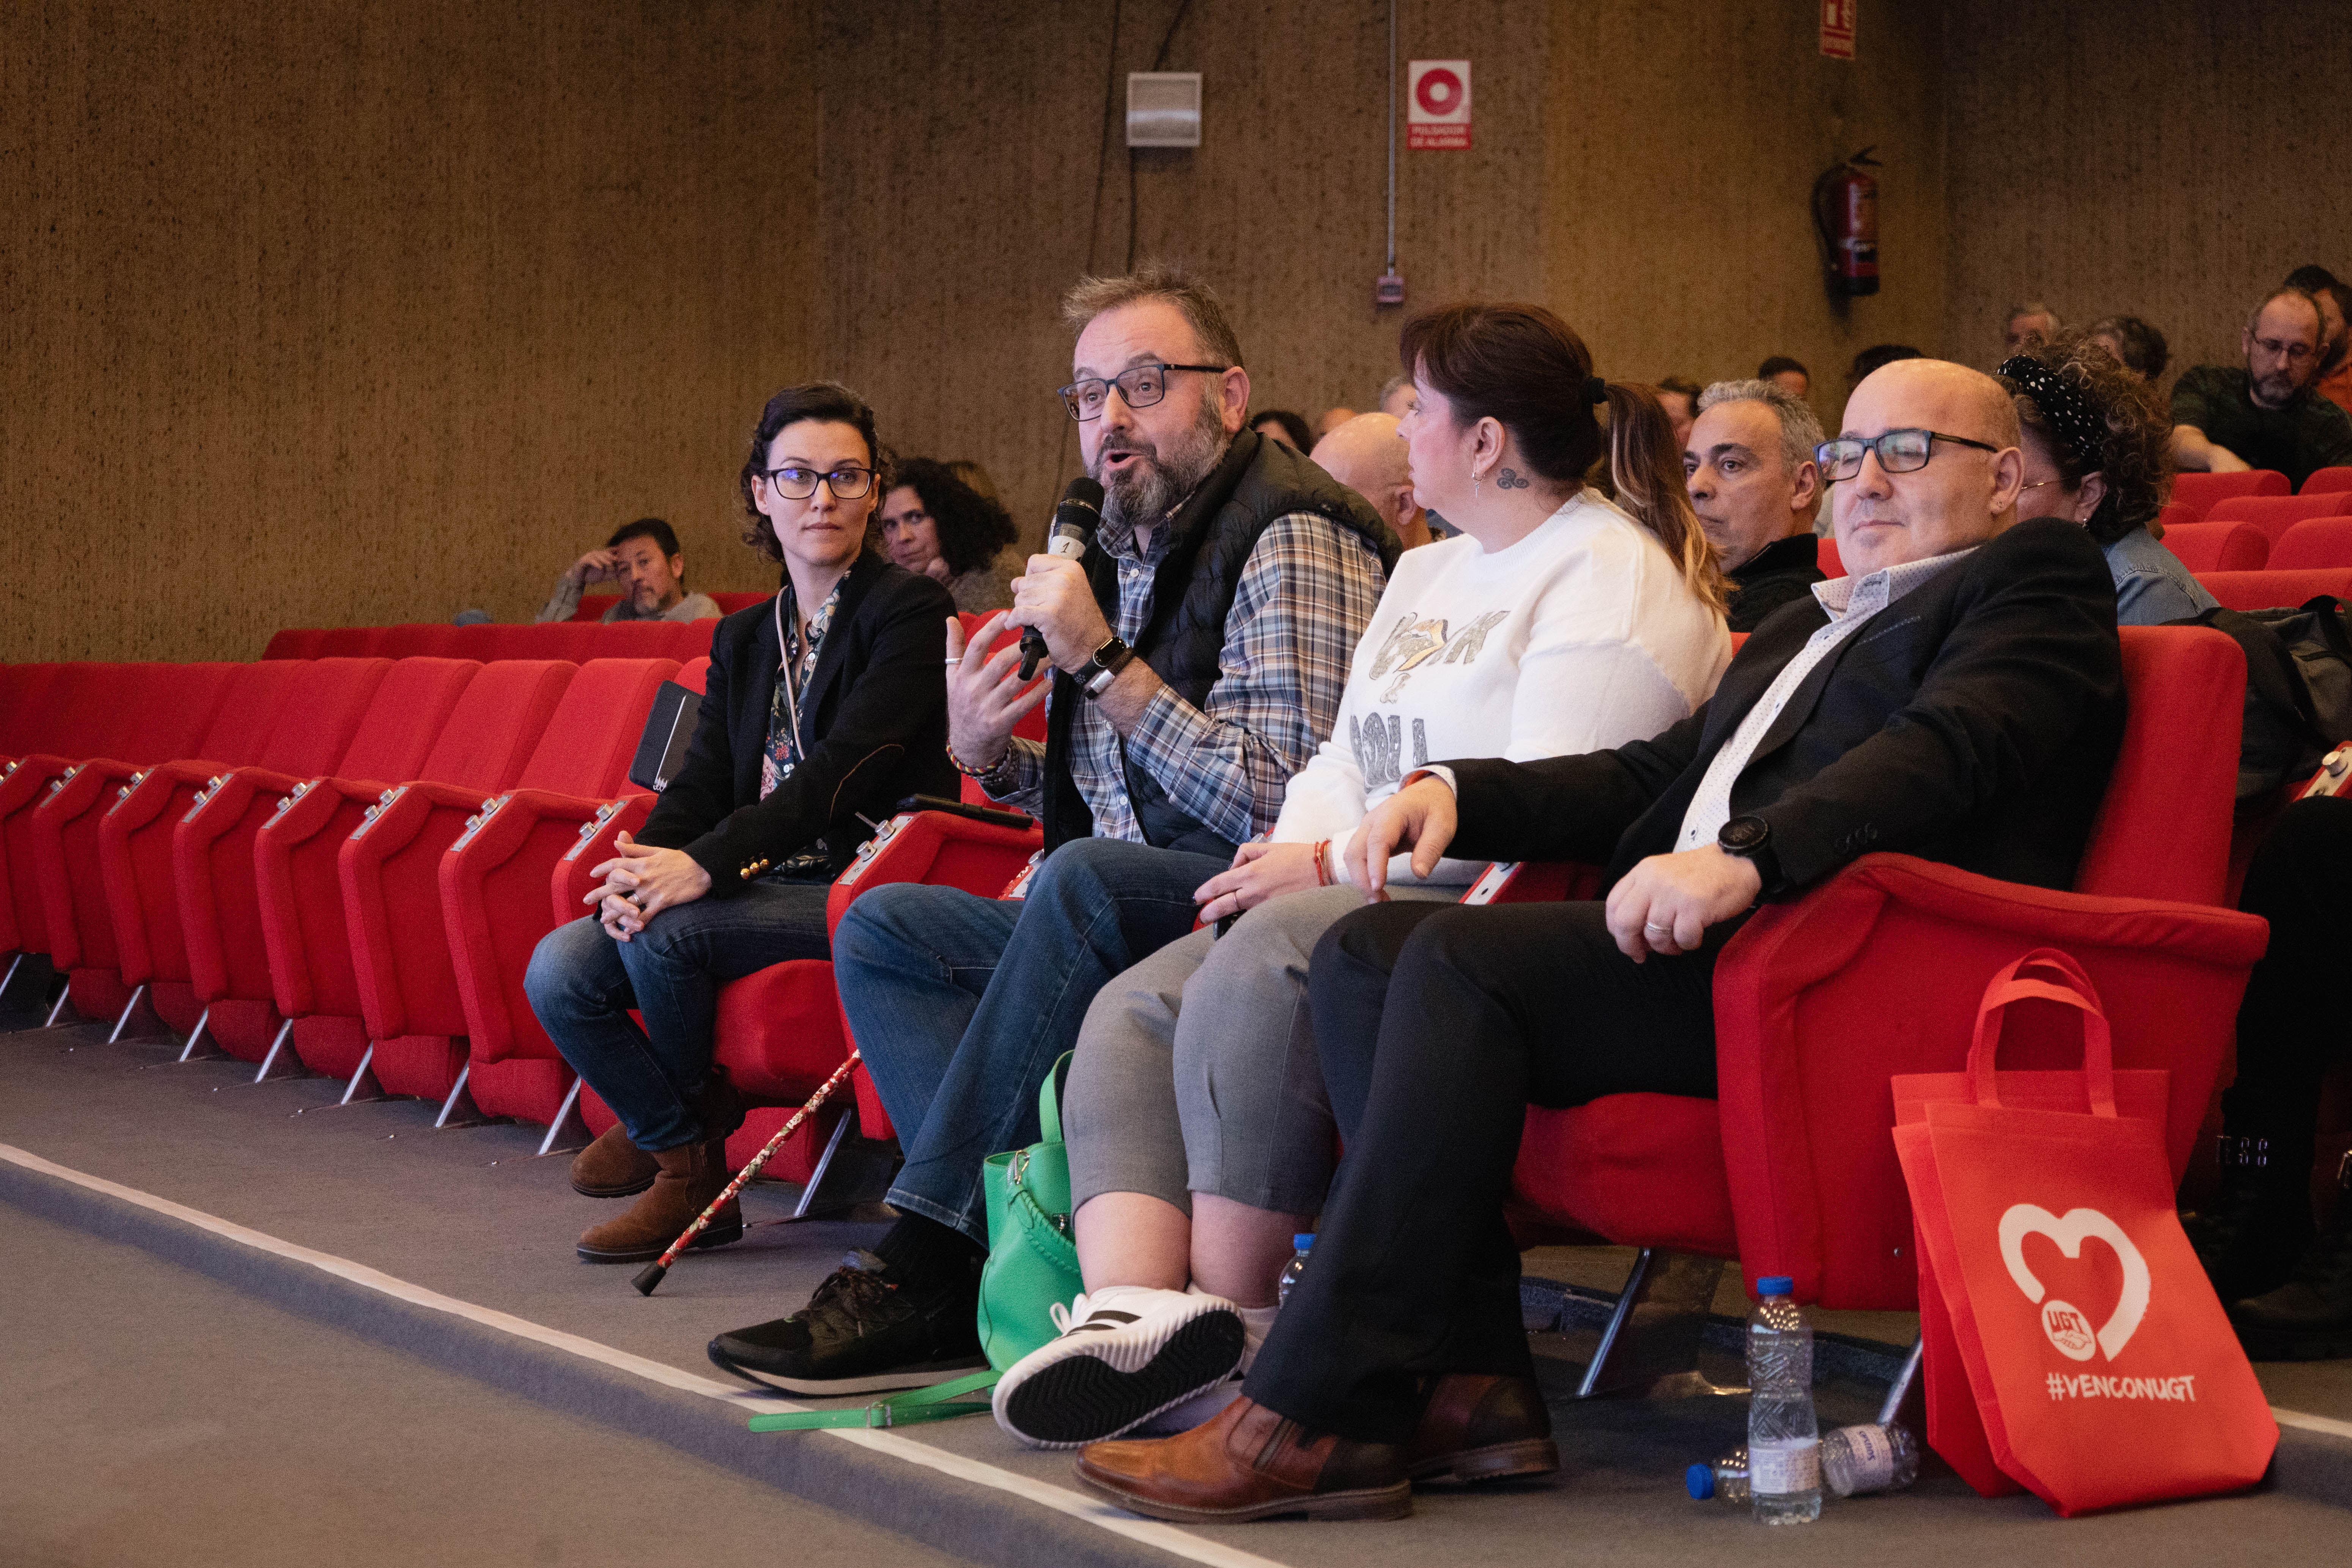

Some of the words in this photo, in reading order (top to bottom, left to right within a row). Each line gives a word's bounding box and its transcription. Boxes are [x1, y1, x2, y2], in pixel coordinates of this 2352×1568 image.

[1060, 542, 1070, 553] 1
[2047, 1310, 2085, 1335] UGT
[2046, 1372, 2196, 1401] #VENCONUGT
